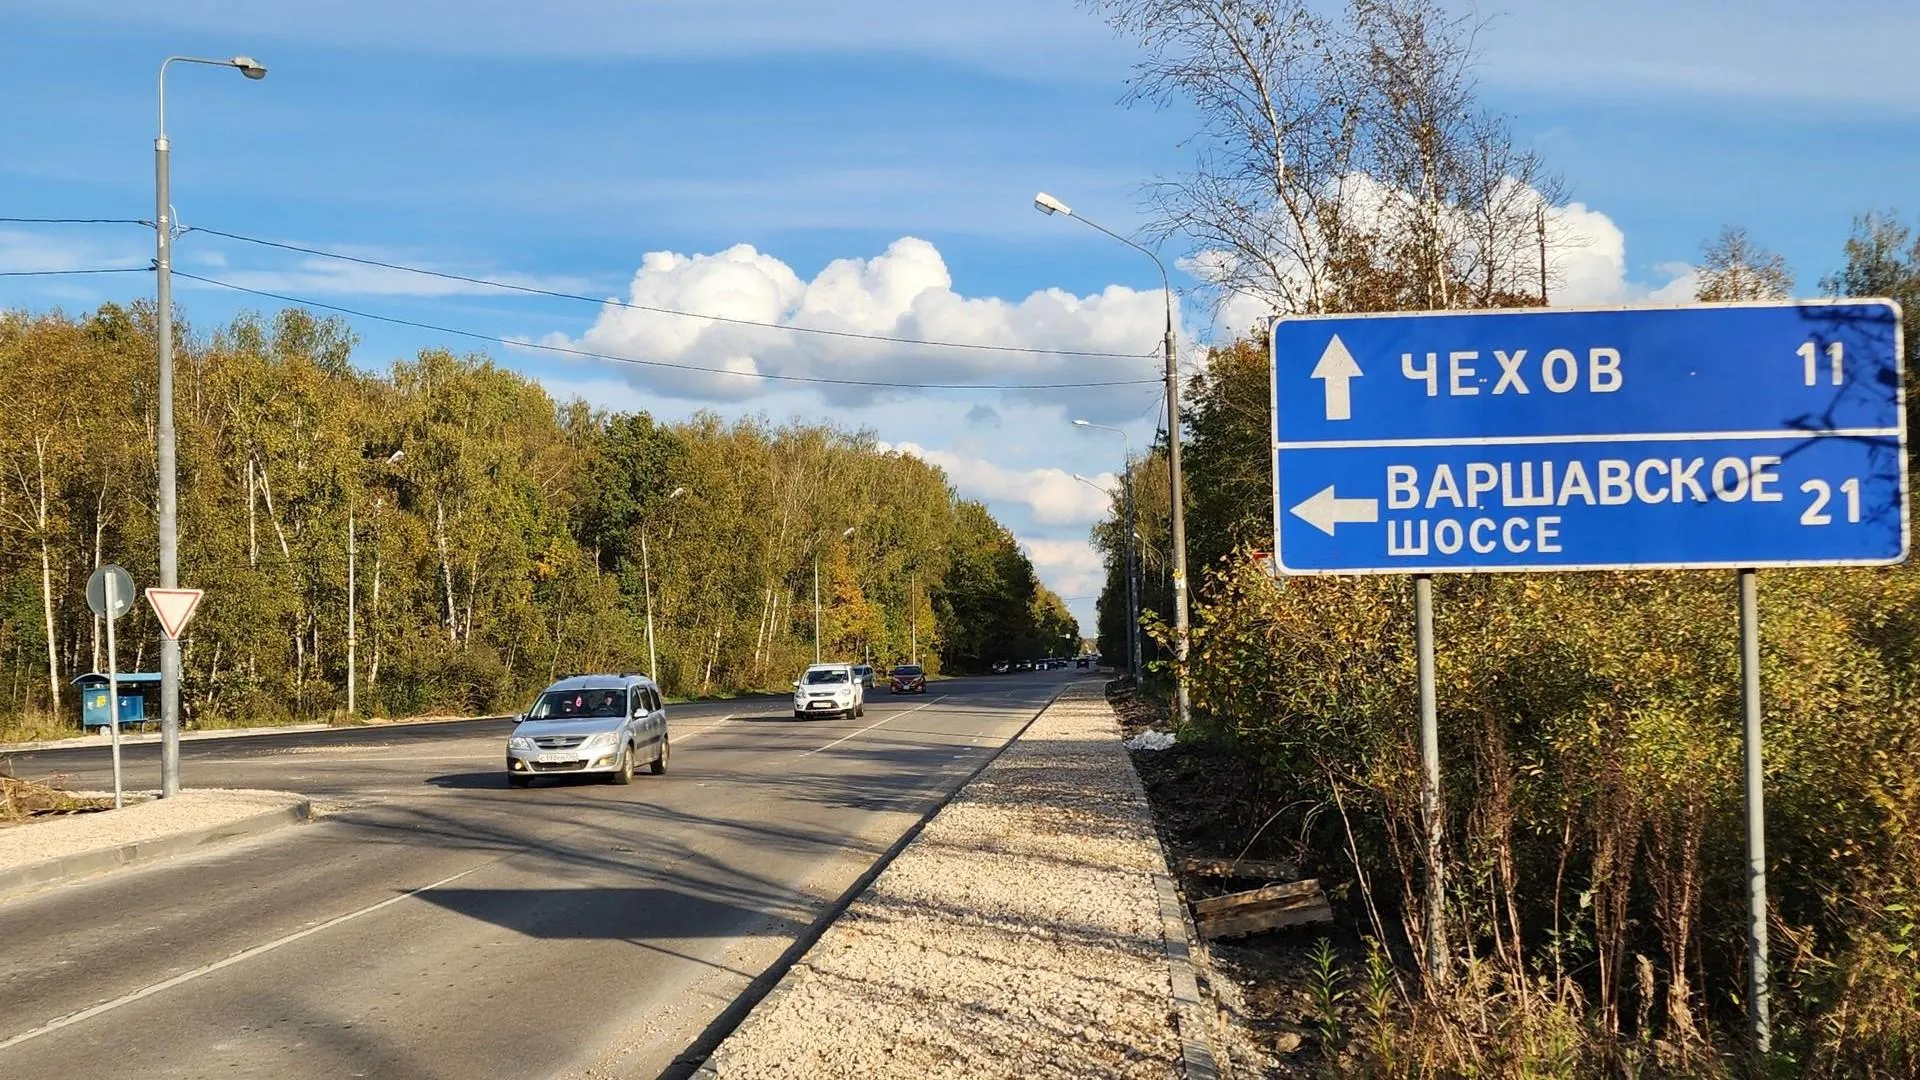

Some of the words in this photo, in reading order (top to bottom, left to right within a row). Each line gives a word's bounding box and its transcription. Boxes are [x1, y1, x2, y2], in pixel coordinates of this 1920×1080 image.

[1401, 347, 1623, 398] ЧЕХОВ
[1795, 341, 1844, 387] 11
[1387, 455, 1784, 510] ВАРШАВСКОЕ
[1799, 478, 1861, 526] 21
[1387, 516, 1562, 556] ШОССЕ
